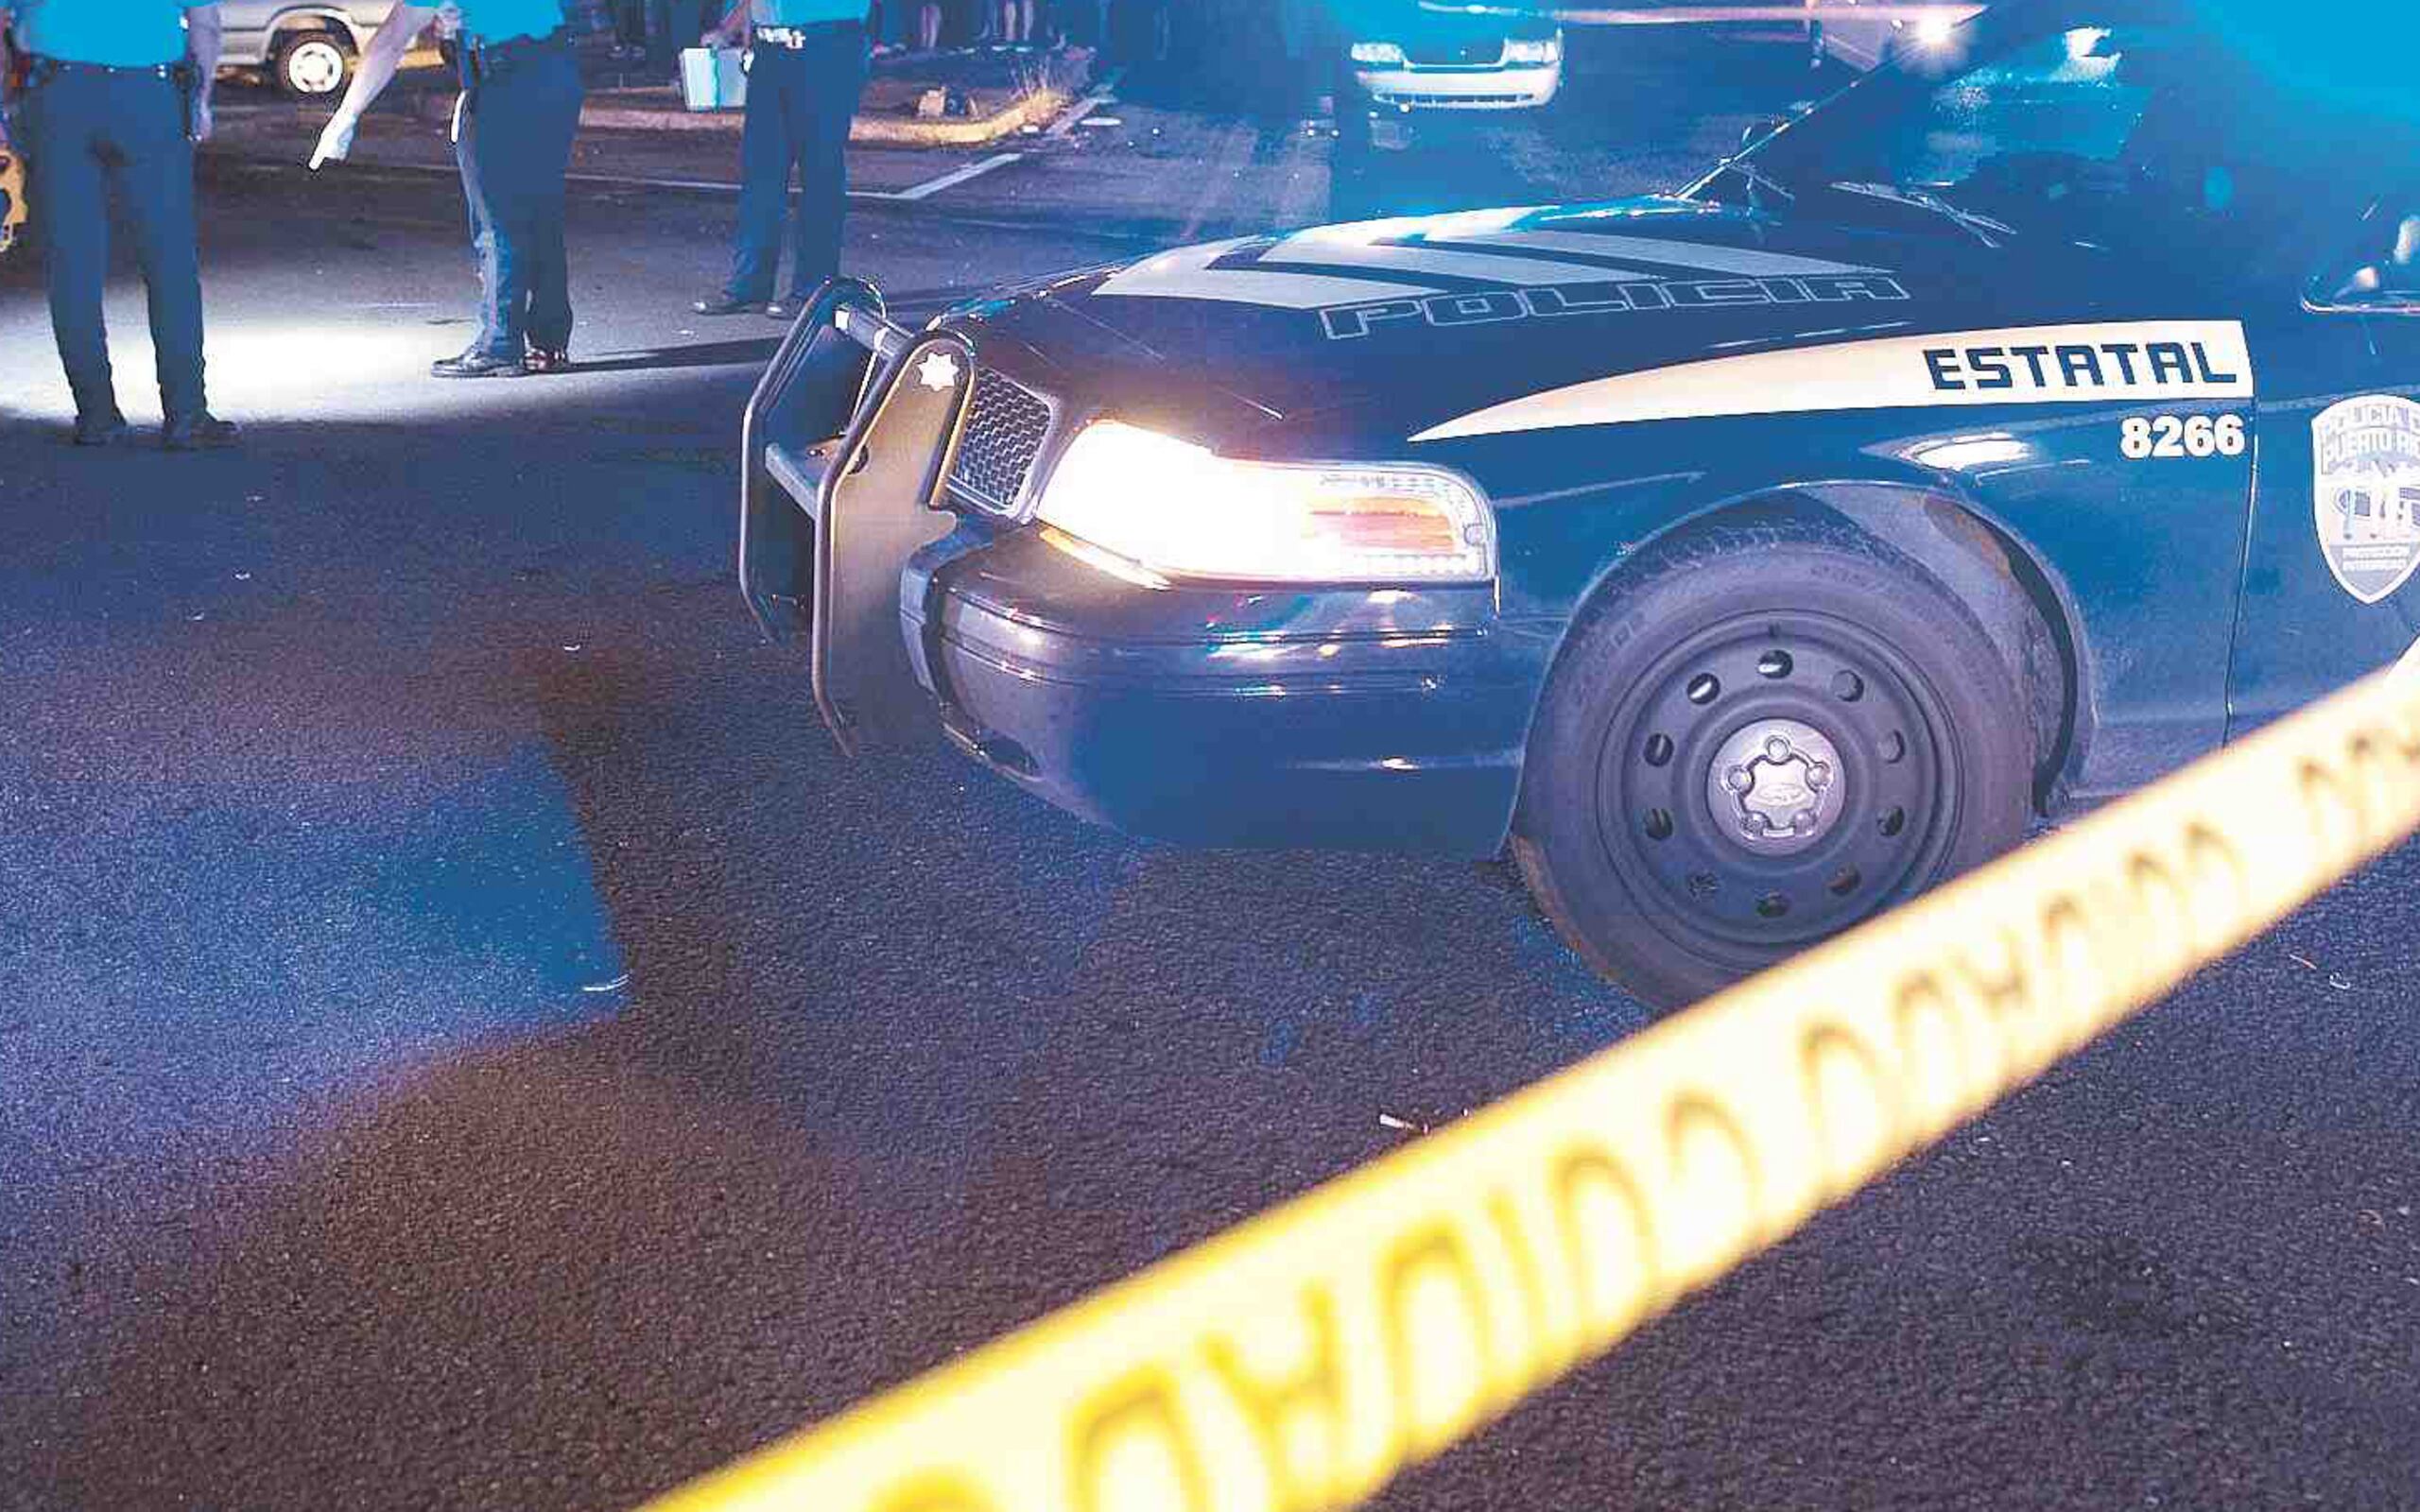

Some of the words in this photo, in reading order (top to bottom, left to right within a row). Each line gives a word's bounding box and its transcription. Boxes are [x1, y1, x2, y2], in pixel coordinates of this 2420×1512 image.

[1320, 276, 1910, 339] POLICIA
[1923, 341, 2238, 390] ESTATAL
[2119, 414, 2246, 459] 8266
